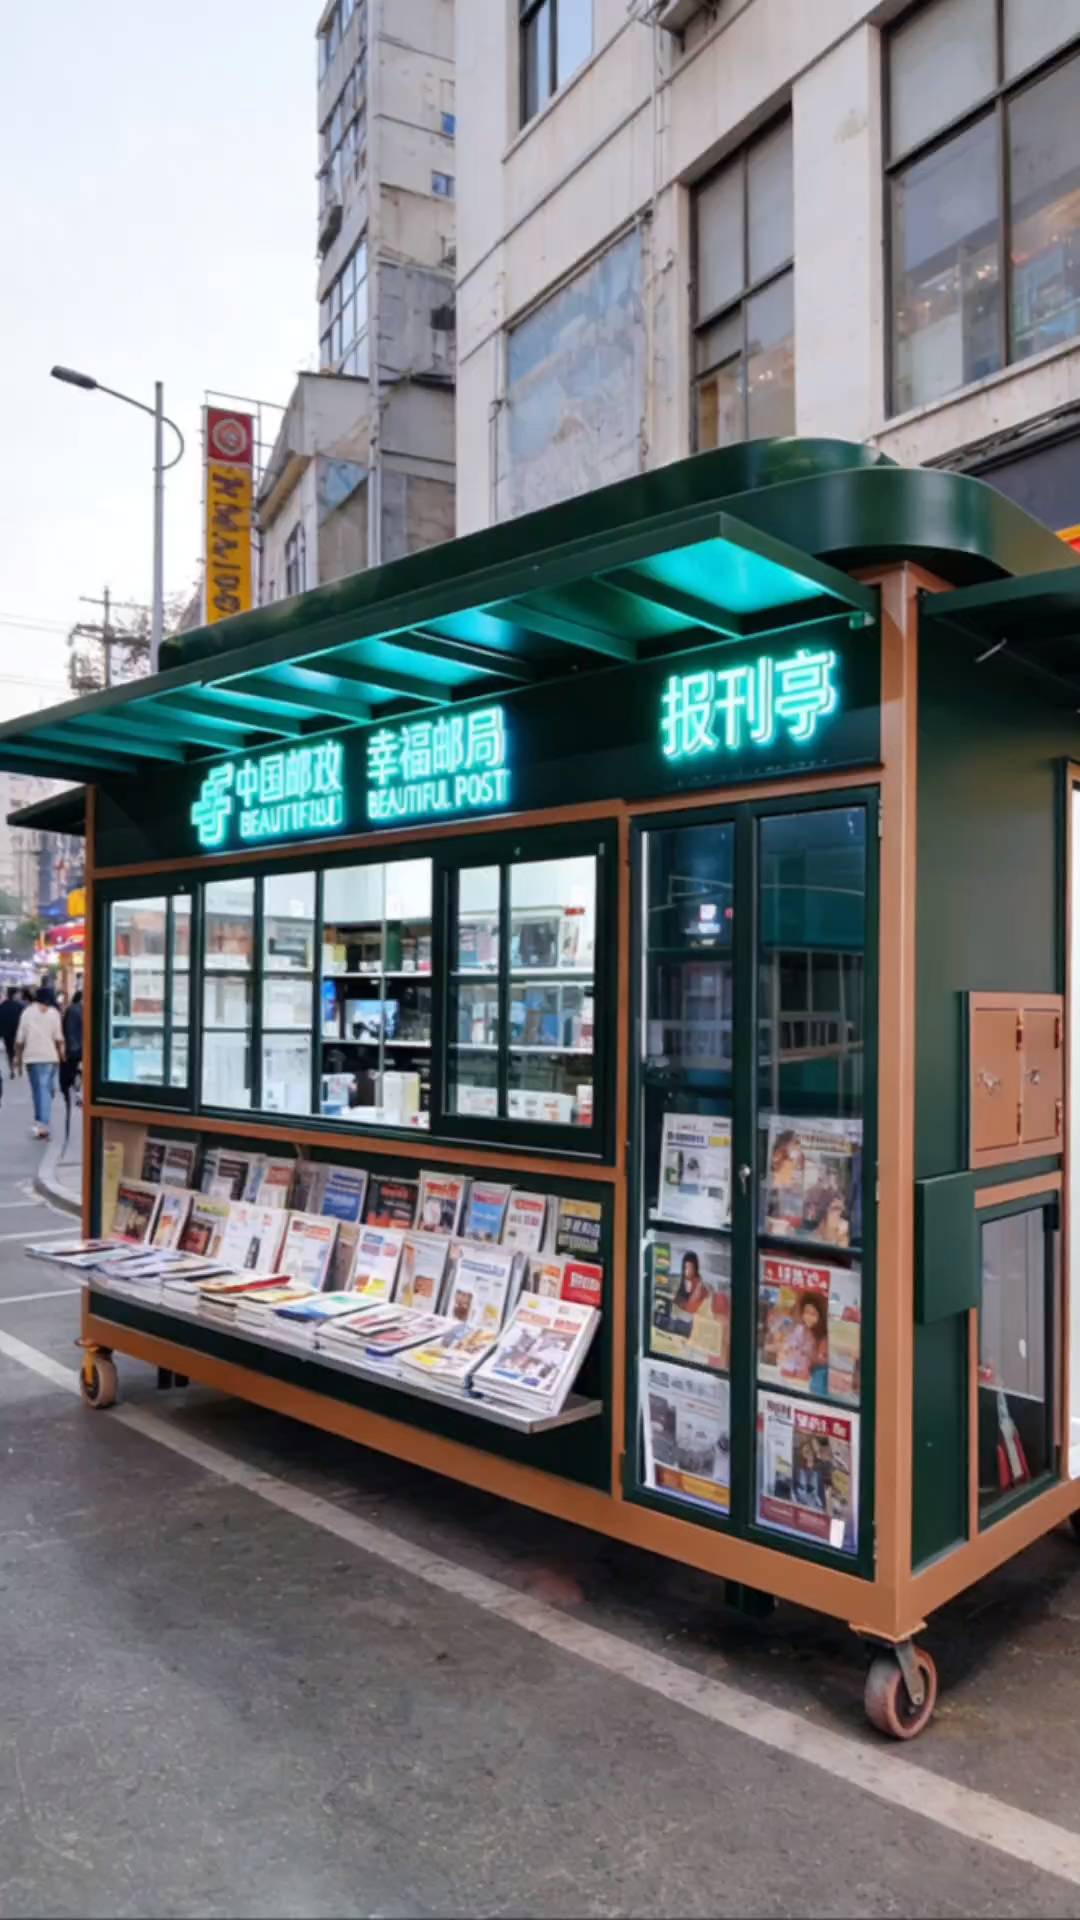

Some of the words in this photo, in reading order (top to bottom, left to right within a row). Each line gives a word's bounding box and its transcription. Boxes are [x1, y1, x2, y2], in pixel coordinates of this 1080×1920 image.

[661, 649, 838, 756] 报刊亭
[367, 705, 506, 785] 幸福邮局
[367, 778, 453, 820] BEAUTIFUL
[454, 768, 511, 807] POST
